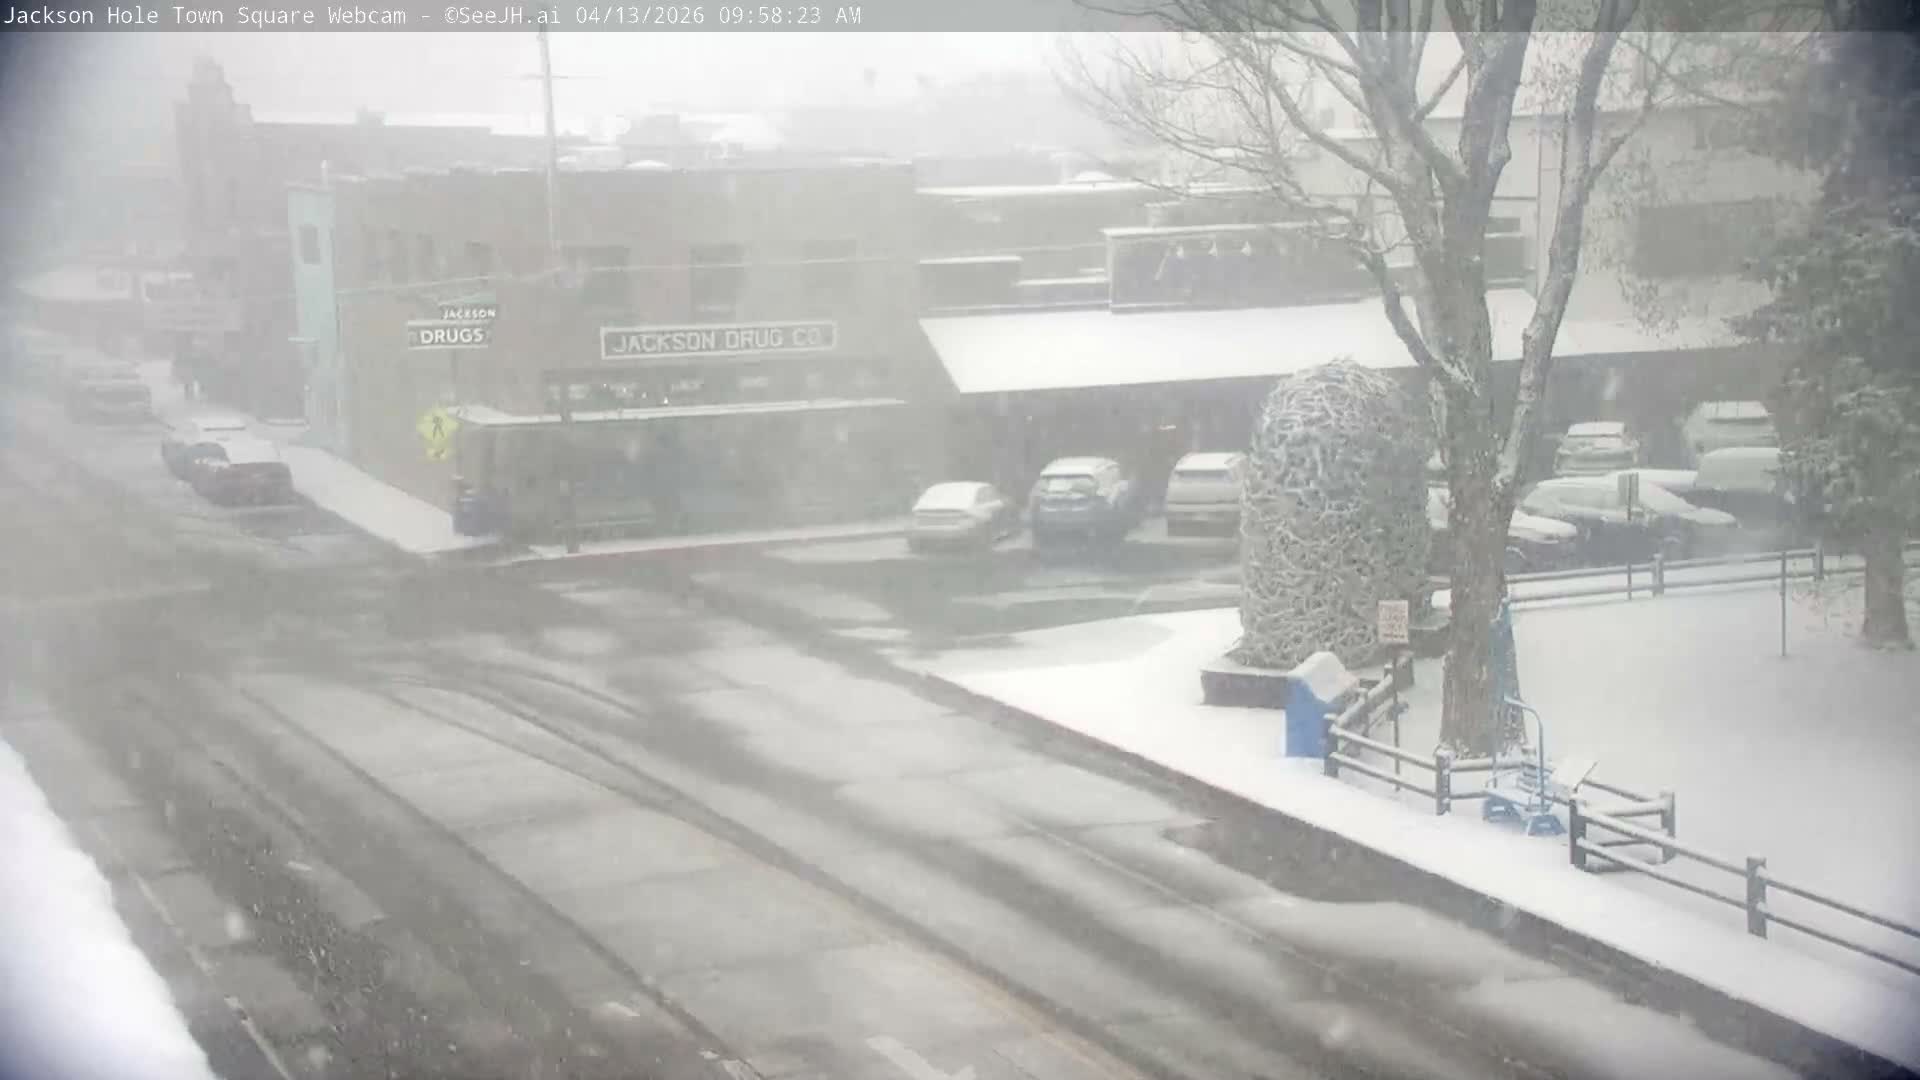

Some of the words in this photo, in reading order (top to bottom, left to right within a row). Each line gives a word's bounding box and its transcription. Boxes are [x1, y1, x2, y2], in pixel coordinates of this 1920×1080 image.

[443, 309, 496, 320] JACKSON
[420, 328, 484, 345] DRUGS
[612, 330, 716, 353] JACKSON
[725, 328, 784, 349] DRUG
